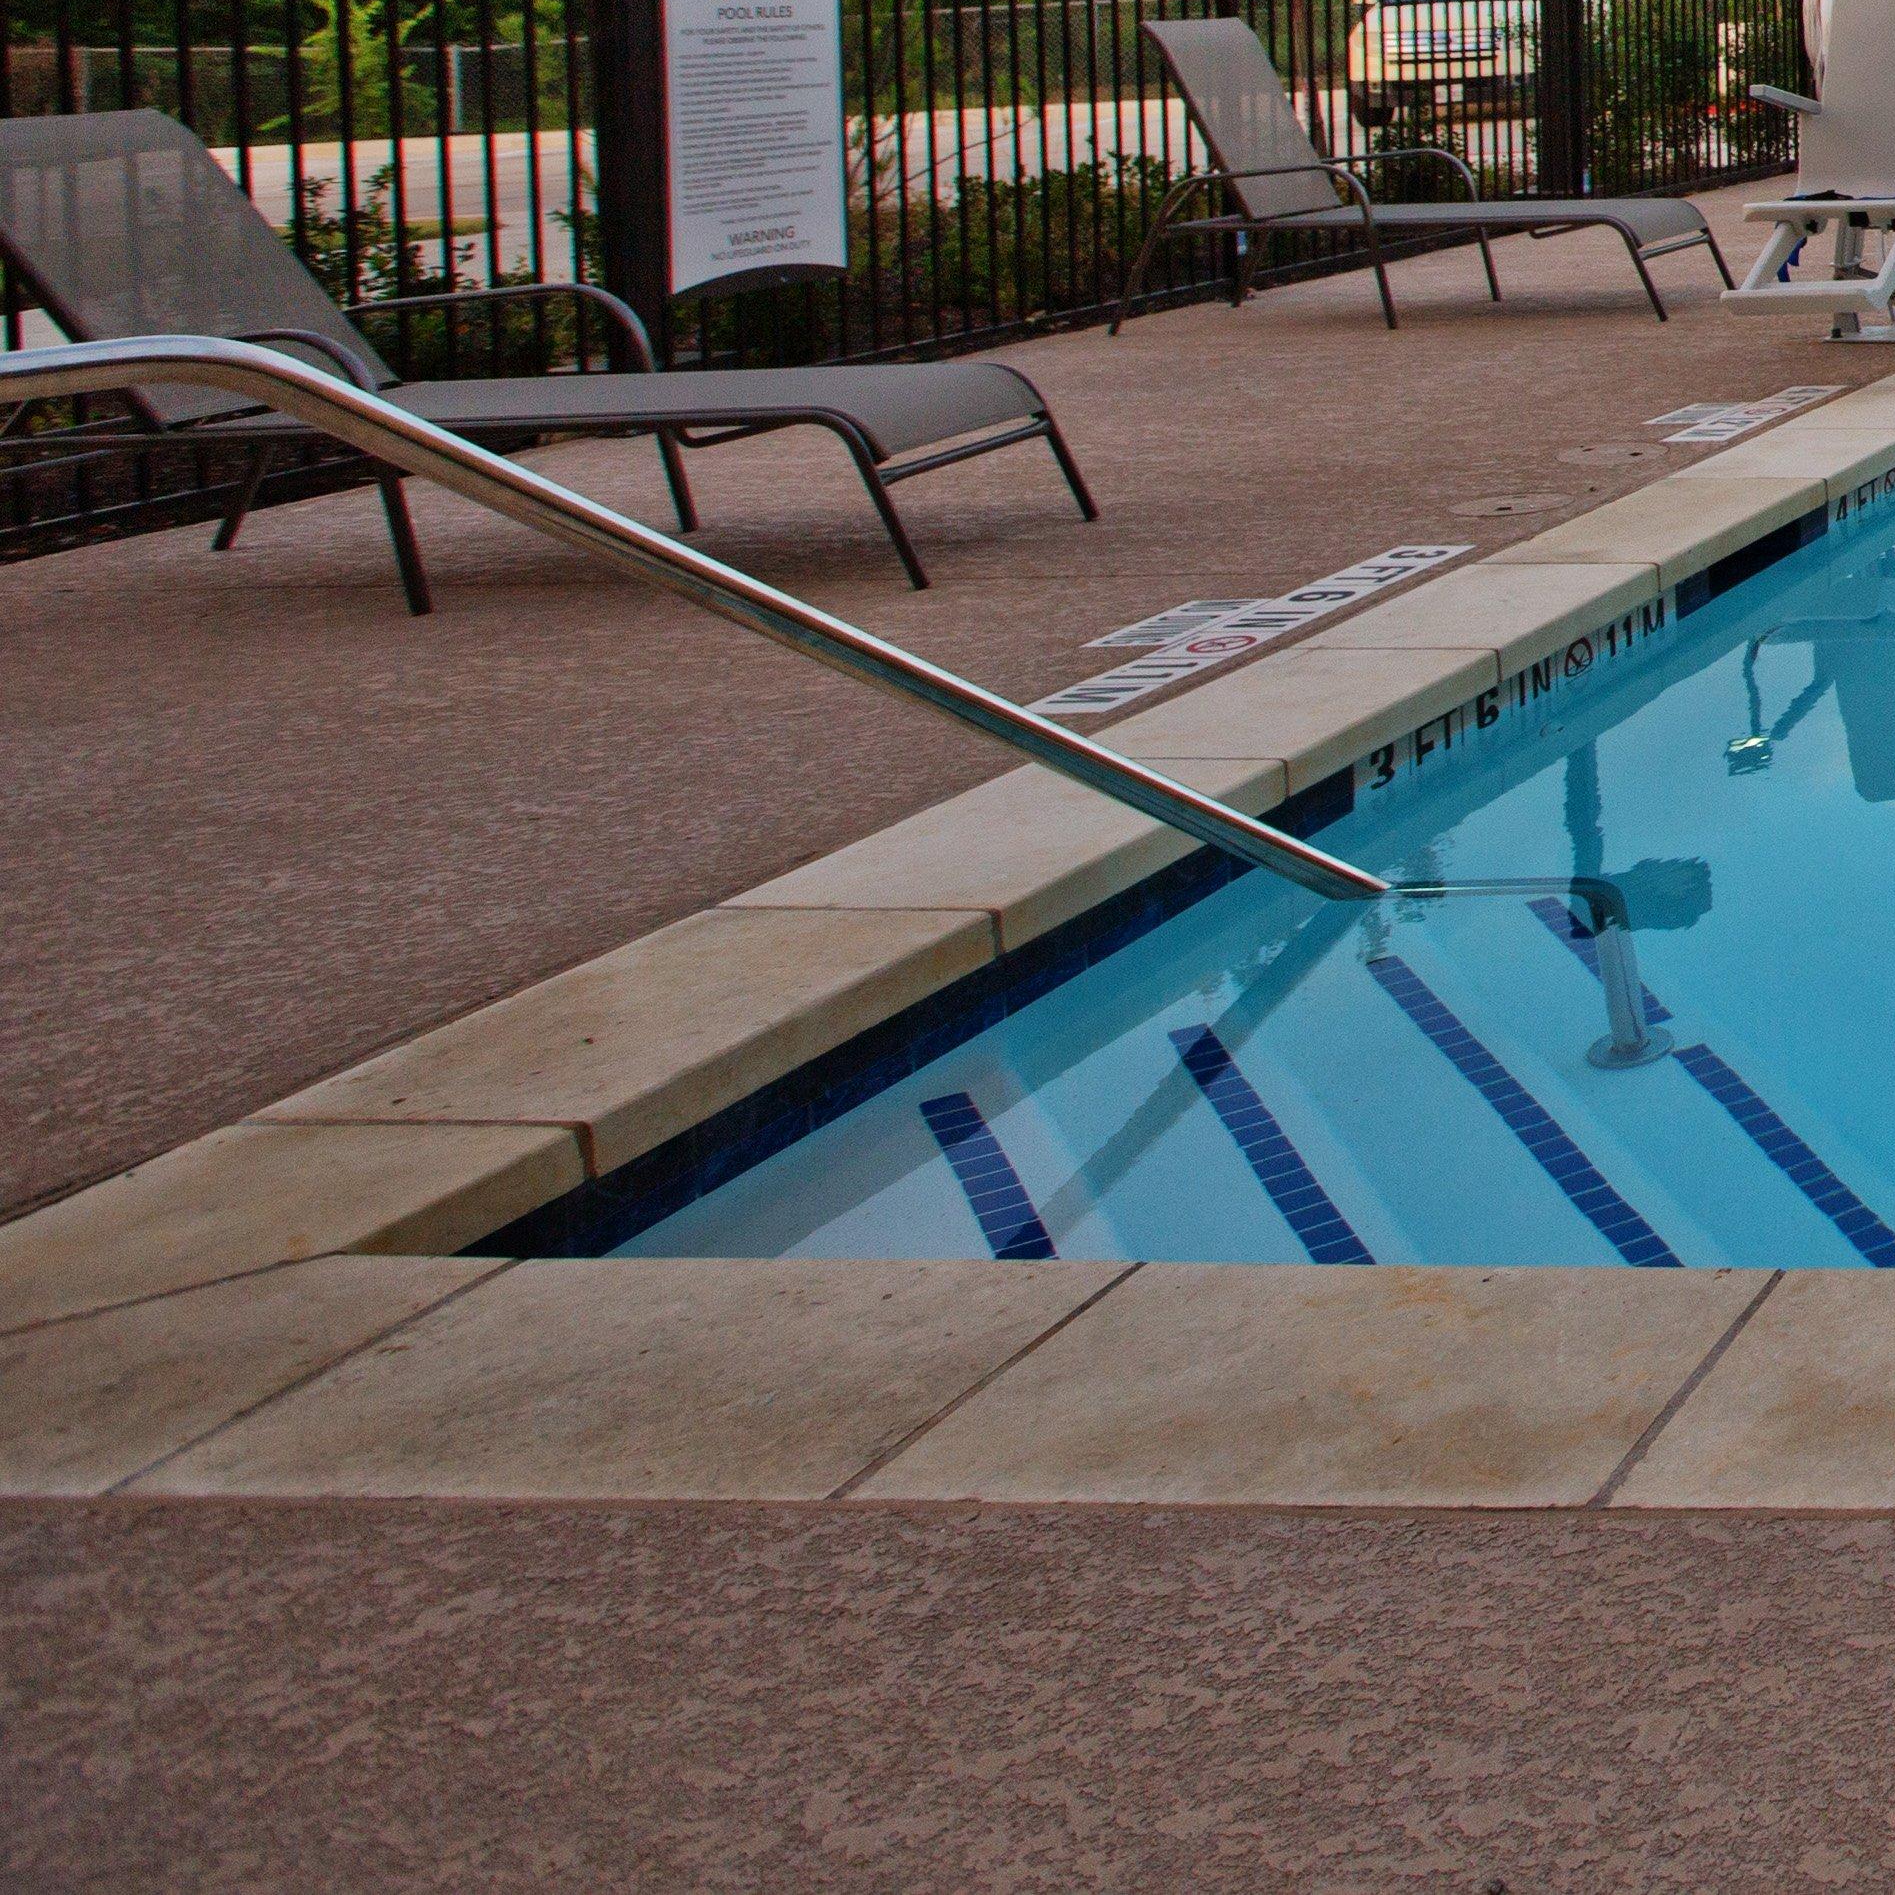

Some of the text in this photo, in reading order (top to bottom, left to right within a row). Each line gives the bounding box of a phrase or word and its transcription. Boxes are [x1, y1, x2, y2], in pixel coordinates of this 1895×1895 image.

[717, 4, 793, 20] POOL RULES
[728, 225, 796, 247] WARNING
[1387, 549, 1449, 560] 3
[1333, 565, 1416, 584] FT
[1288, 590, 1357, 603] 6
[1221, 610, 1316, 629] IN
[1046, 686, 1145, 705] M
[1370, 742, 1395, 791] 3
[1414, 707, 1459, 768] FT
[1476, 687, 1500, 730] 6
[1518, 655, 1552, 709] IN
[1642, 597, 1665, 638] M
